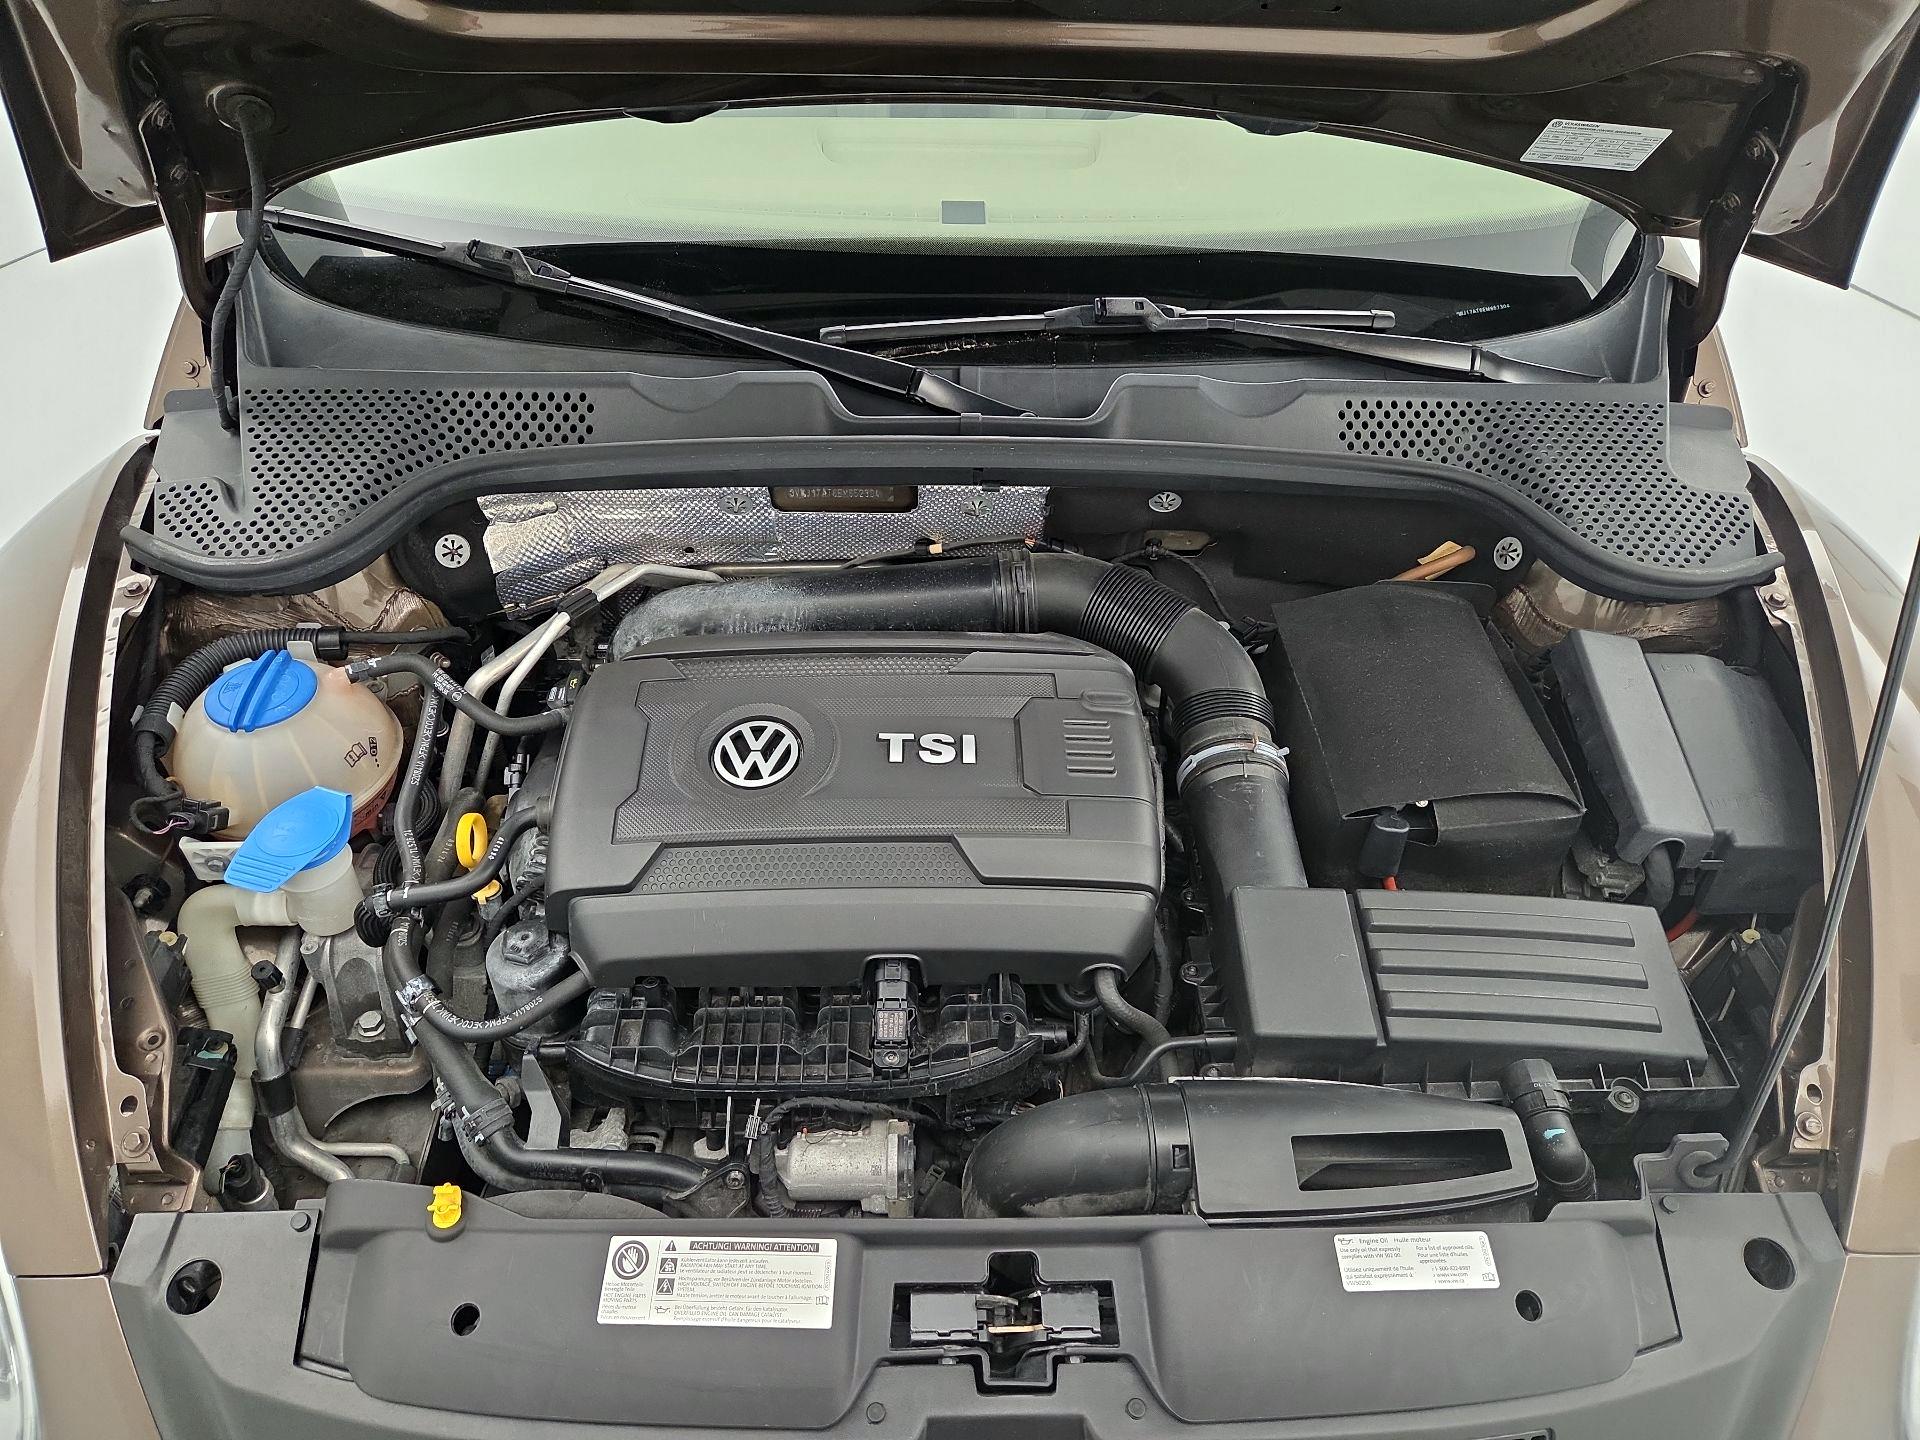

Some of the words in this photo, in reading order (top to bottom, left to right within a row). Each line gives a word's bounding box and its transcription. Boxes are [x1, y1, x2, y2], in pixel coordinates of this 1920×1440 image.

[713, 719, 800, 788] VW
[878, 732, 979, 765] TSI
[692, 1242, 732, 1250] ACHTUNG!
[734, 1242, 772, 1251] WARNING!
[774, 1243, 817, 1252] ATTENTION!
